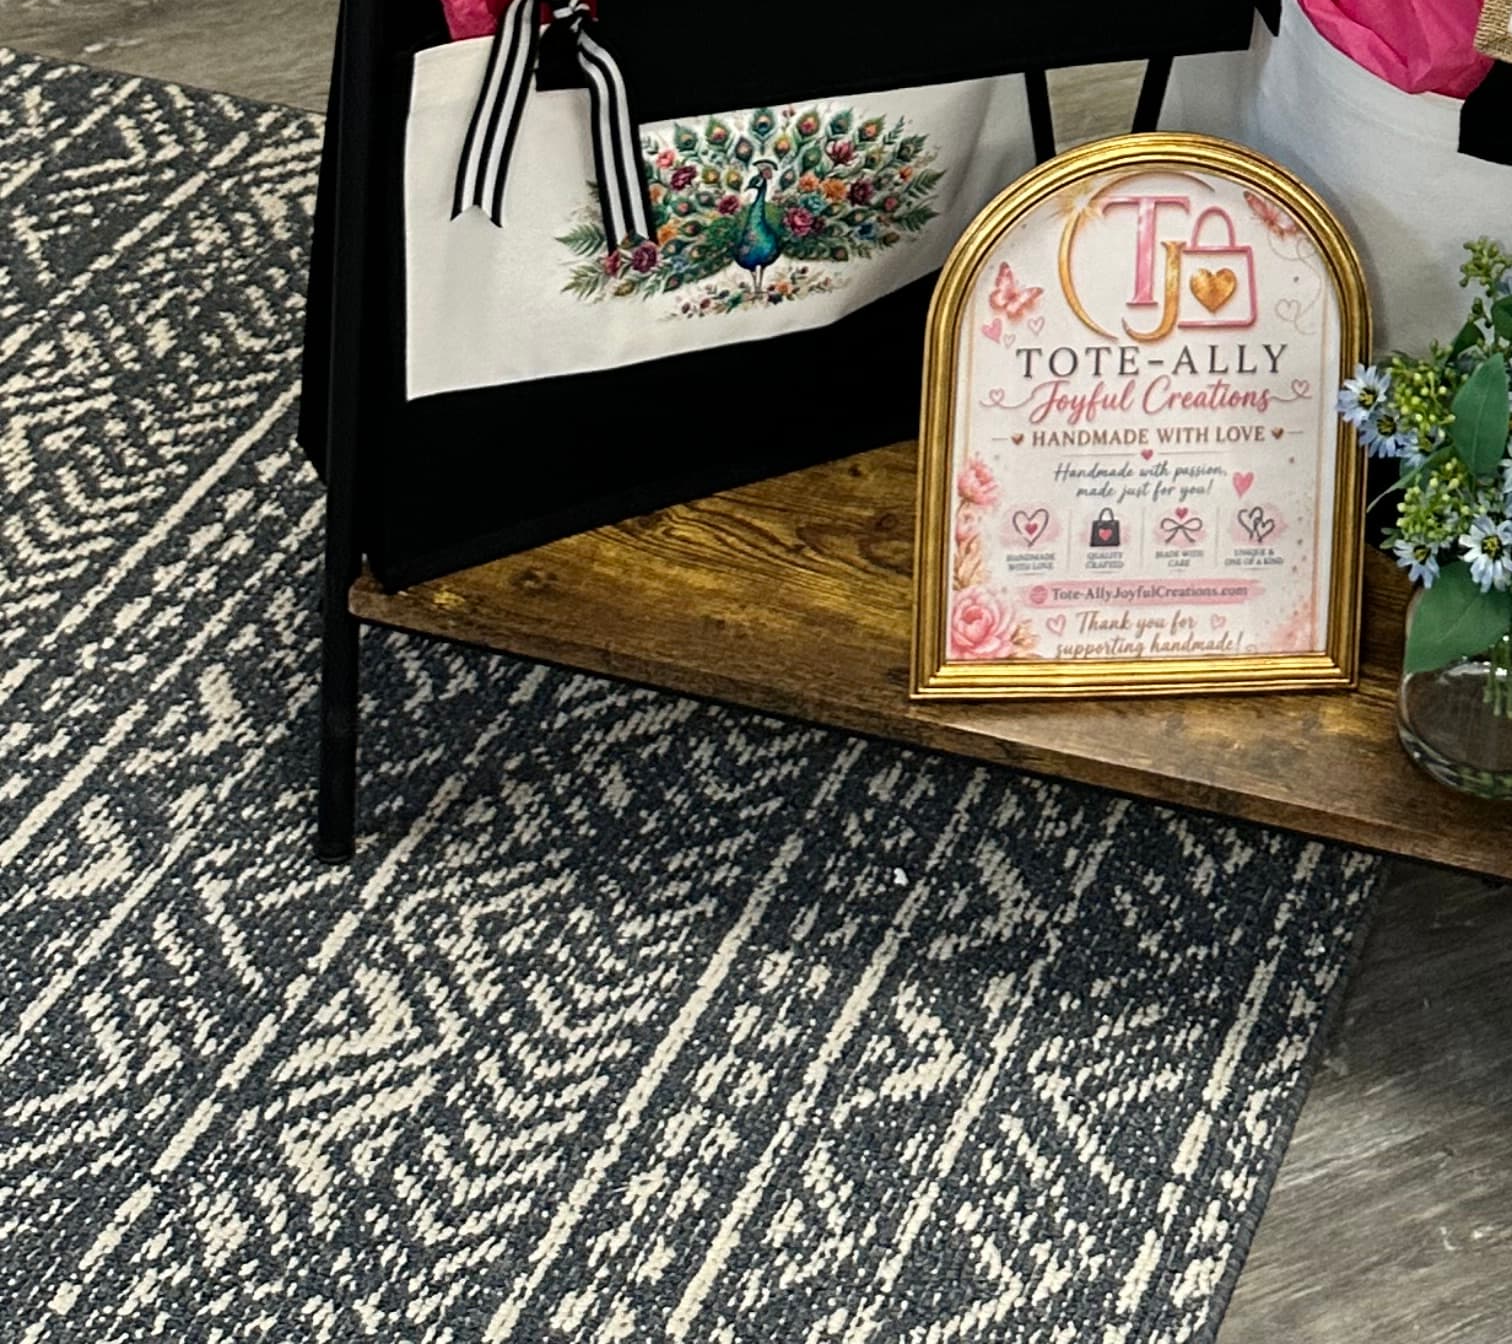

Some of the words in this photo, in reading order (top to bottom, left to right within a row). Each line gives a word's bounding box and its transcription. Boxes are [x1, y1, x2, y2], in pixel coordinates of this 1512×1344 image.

[1015, 344, 1289, 379] TOTE-ALLY
[1029, 376, 1137, 425] Joyful
[1141, 374, 1272, 414] Creations
[1032, 428, 1149, 447] HANDMADE
[1156, 427, 1209, 445] WITH
[1215, 425, 1266, 443] LOVE
[1053, 463, 1134, 481] Handmade
[1139, 463, 1169, 478] with
[1076, 481, 1115, 498] made
[1116, 482, 1150, 503] just
[1152, 481, 1175, 502] for
[1179, 481, 1213, 502] you!
[1052, 586, 1248, 603] Tote-AllyJoyfulCreations.com
[1076, 611, 1132, 635] Thank
[1136, 617, 1167, 637] you
[1169, 611, 1198, 637] for
[1056, 636, 1145, 658] supporting
[1149, 631, 1245, 653] handmade!
